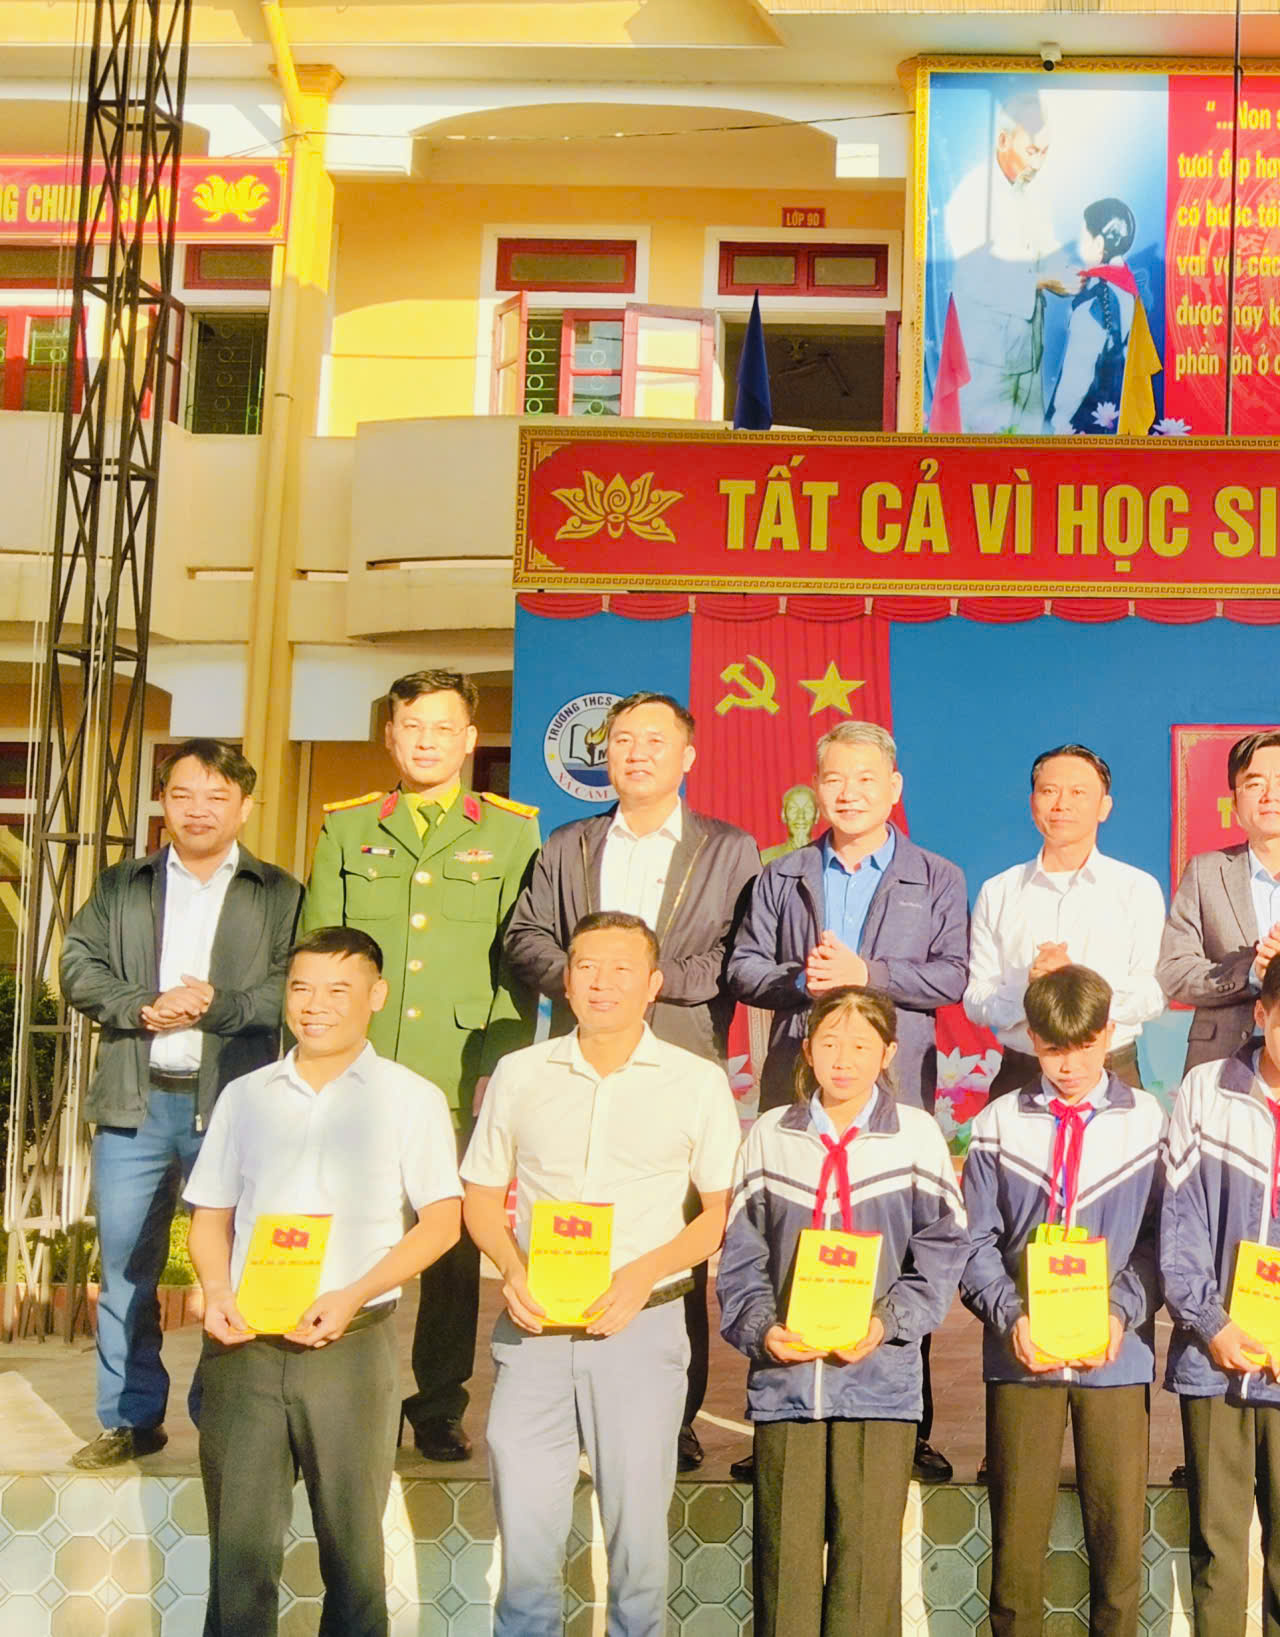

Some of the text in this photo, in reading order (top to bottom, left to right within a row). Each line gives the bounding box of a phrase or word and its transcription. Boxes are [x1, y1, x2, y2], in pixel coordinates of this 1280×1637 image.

[1178, 149, 1213, 179] tươi
[1177, 199, 1200, 228] có
[1176, 248, 1206, 277] vai
[1176, 294, 1223, 335] được
[1176, 342, 1220, 381] phần
[1229, 345, 1252, 375] ớn
[719, 455, 839, 552] TẤT
[860, 457, 950, 554] CẢ
[972, 468, 1032, 555] VÌ
[1058, 483, 1190, 573] HỌC
[582, 696, 612, 708] THCS
